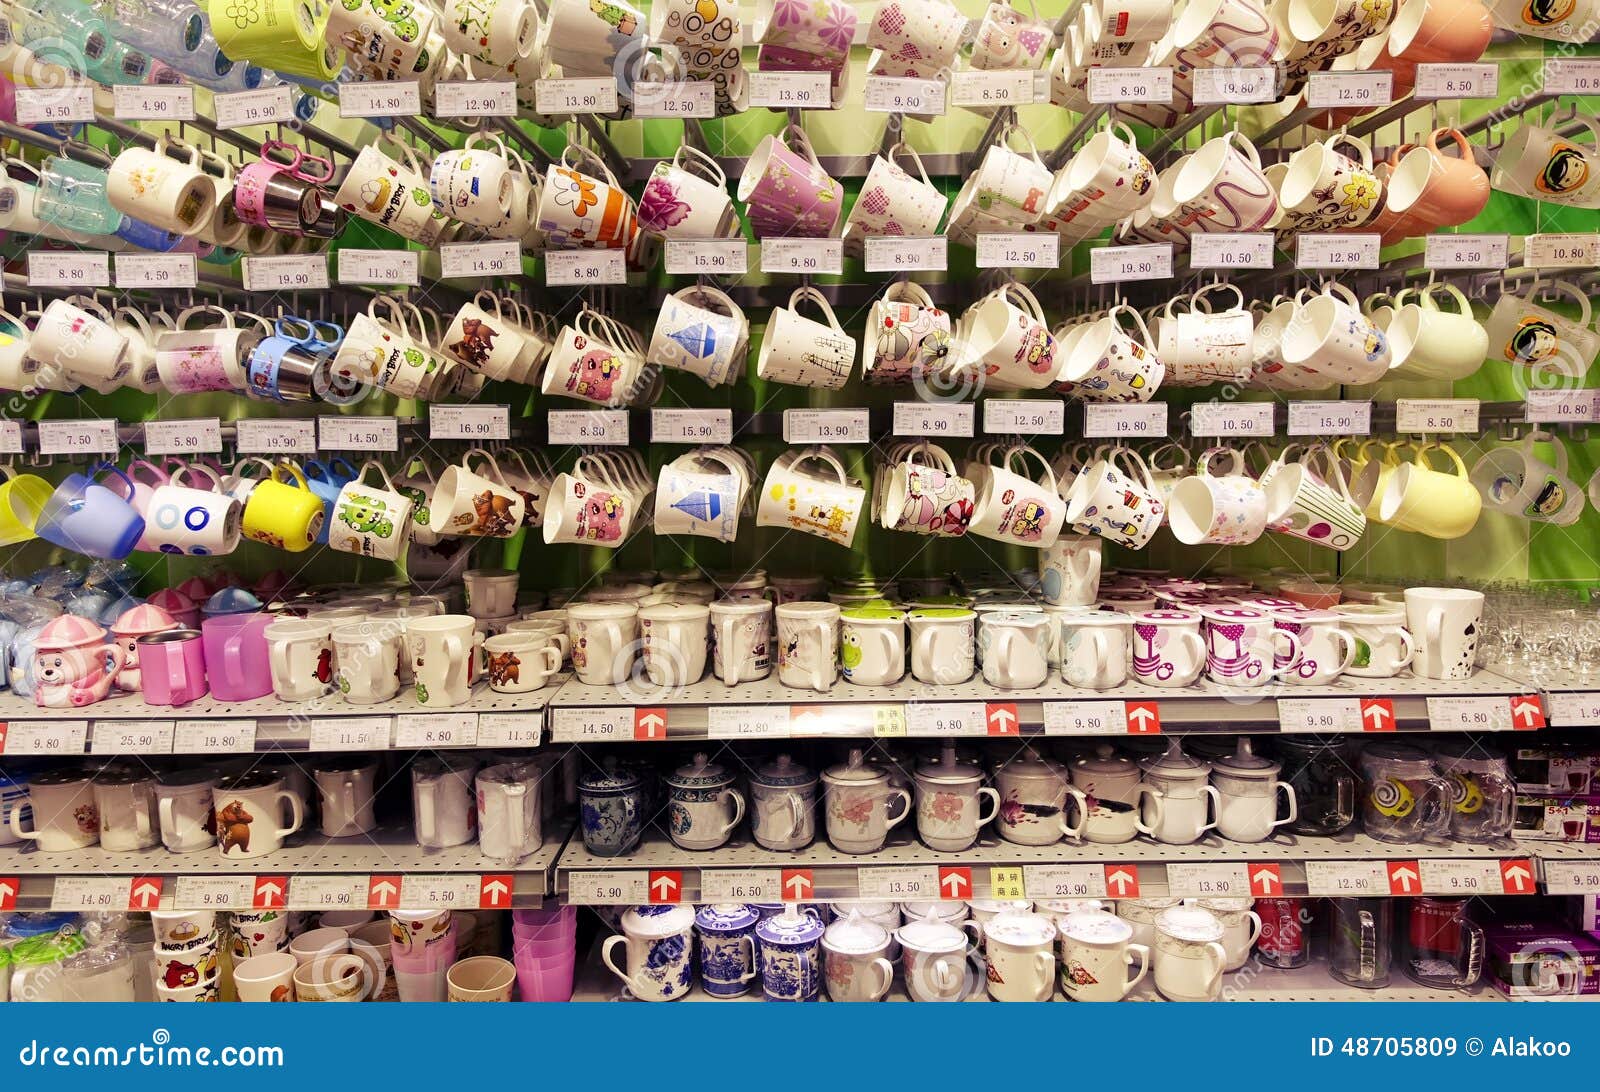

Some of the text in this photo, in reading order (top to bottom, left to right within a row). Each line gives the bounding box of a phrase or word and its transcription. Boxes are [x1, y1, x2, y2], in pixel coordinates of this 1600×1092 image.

[1120, 86, 1146, 96] 8.90
[1223, 83, 1254, 94] 19.80
[1446, 80, 1472, 91] 8.50
[779, 90, 810, 101] 13.80
[982, 89, 1008, 100] 8.50
[1338, 89, 1369, 99] 12.50
[142, 101, 167, 111] 4.90
[369, 98, 400, 109] 14.80
[465, 99, 496, 110] 12.90
[565, 95, 596, 106] 13.80
[894, 96, 919, 107] 9.80
[45, 106, 70, 117] 9.50
[245, 106, 275, 118] 19.90
[663, 101, 693, 112] 12.50
[895, 254, 919, 264] 8.90
[1005, 251, 1036, 262] 12.50
[1220, 252, 1251, 263] 10.50
[1329, 252, 1360, 263] 12.80
[1455, 251, 1480, 263] 8.50
[1553, 248, 1583, 259] 10.80
[472, 260, 502, 270] 14.90
[694, 255, 725, 266] 15.90
[791, 257, 816, 268] 9.80
[368, 268, 398, 278] 11.80
[574, 267, 599, 278] 8.80
[1121, 262, 1151, 273] 19.80
[58, 269, 83, 280] 8.80
[144, 270, 169, 281] 4.50
[278, 273, 308, 284] 19.90
[1556, 404, 1587, 414] 10.80
[922, 420, 947, 430] 8.90
[1014, 415, 1044, 425] 12.50
[1116, 420, 1147, 431] 19.80
[1222, 419, 1253, 430] 10.50
[1320, 417, 1350, 428] 15.90
[1427, 417, 1452, 428] 8.50
[459, 423, 489, 434] 16.90
[580, 426, 605, 436] 8.80
[682, 426, 712, 437] 15.90
[818, 426, 848, 436] 13.90
[66, 435, 91, 446] 7.50
[174, 436, 198, 447] 5.80
[266, 437, 296, 448] 19.90
[348, 433, 378, 444] 14.50
[1461, 712, 1487, 723] 6.80
[1580, 708, 1600, 719] 1.9
[936, 719, 962, 729] 9.80
[1075, 718, 1101, 729] 9.80
[1307, 715, 1333, 726] 9.80
[582, 723, 613, 734] 14.50
[738, 722, 768, 733] 12.80
[120, 735, 152, 746] 25.90
[204, 736, 235, 747] 19.80
[426, 731, 451, 741] 8.80
[34, 738, 59, 749] 9.80
[1548, 806, 1568, 815] 5+1
[1337, 878, 1368, 889] 12.80
[1451, 877, 1477, 888] 9.50
[1574, 875, 1599, 886] 9.50
[730, 886, 761, 897] 16.50
[889, 882, 919, 893] 13.50
[997, 888, 1019, 896] 商品
[1055, 884, 1087, 895] 23.90
[1198, 881, 1229, 892] 13.80
[429, 890, 454, 902] 5.50
[596, 887, 621, 898] 5.90
[81, 894, 111, 905] 14.80
[203, 893, 228, 904] 9.80
[320, 893, 350, 904] 19.90
[161, 934, 209, 952] ANGRY BIRDS
